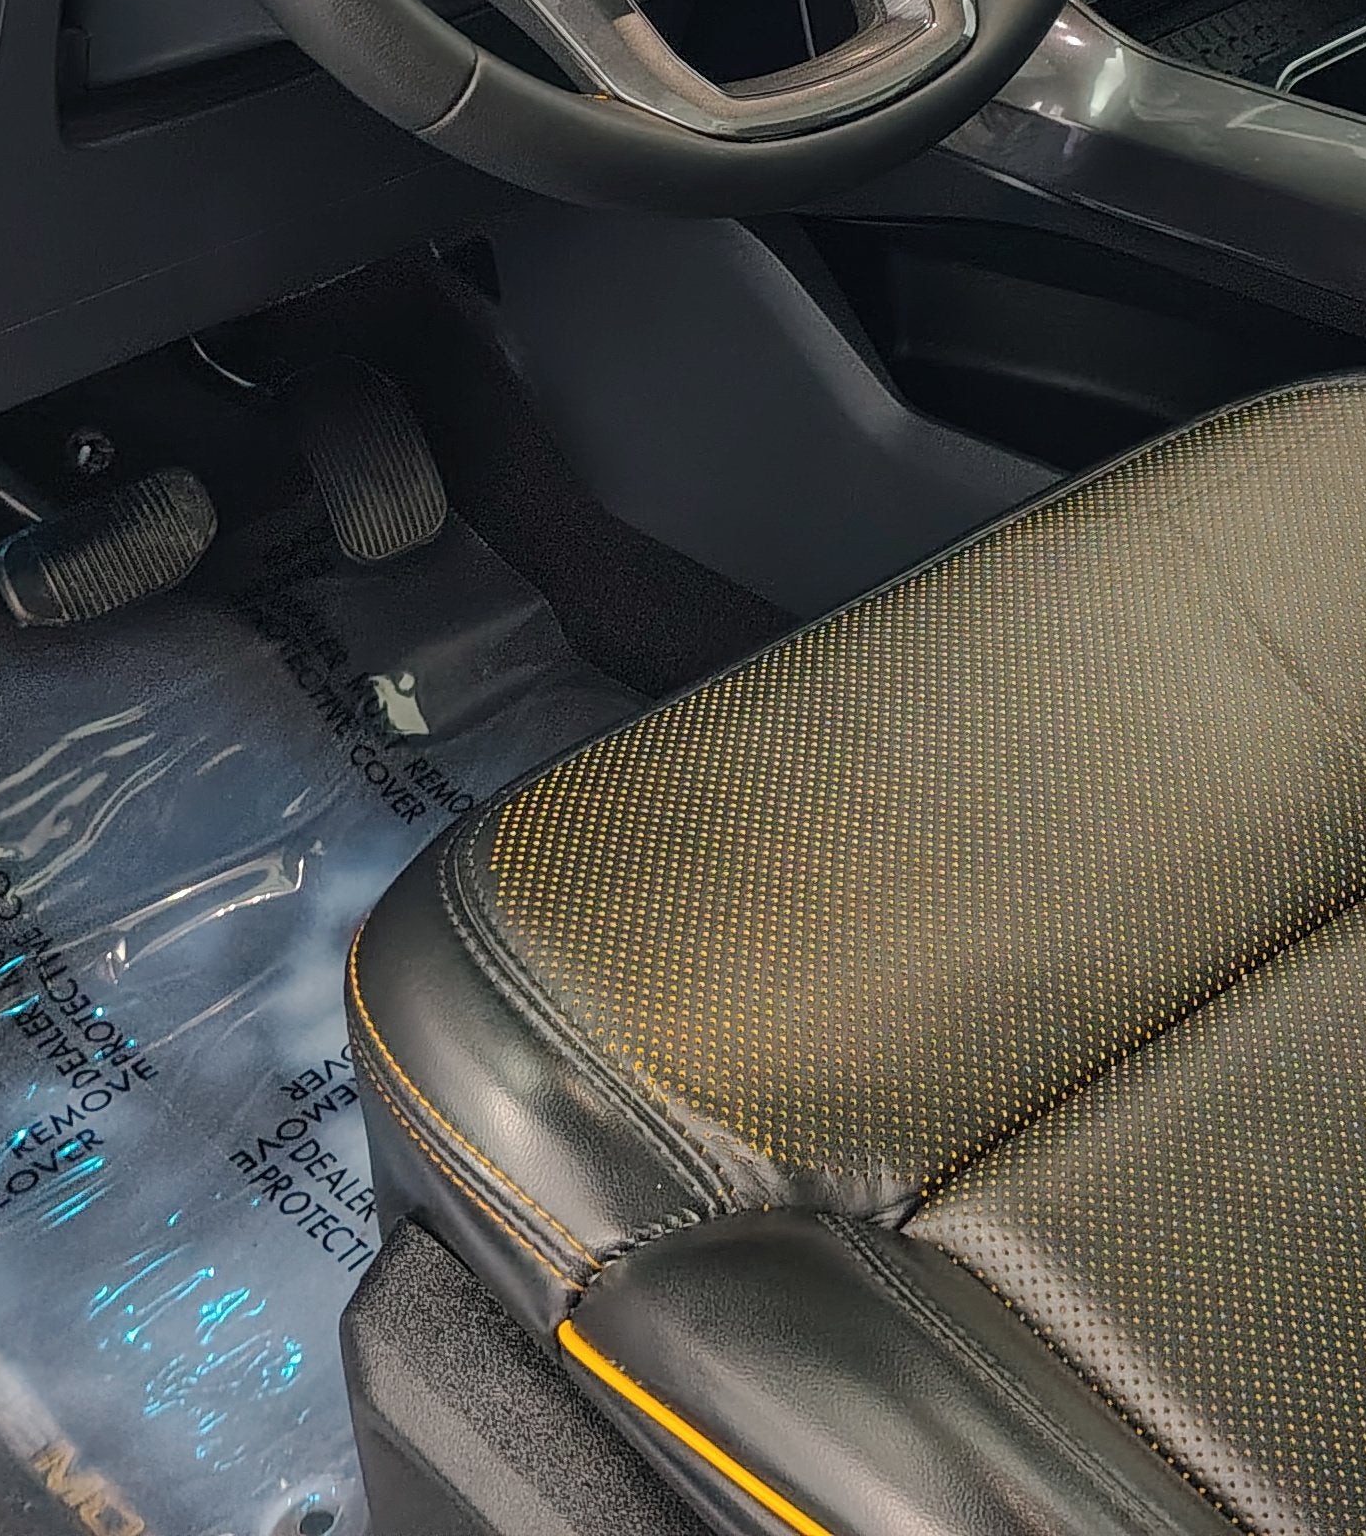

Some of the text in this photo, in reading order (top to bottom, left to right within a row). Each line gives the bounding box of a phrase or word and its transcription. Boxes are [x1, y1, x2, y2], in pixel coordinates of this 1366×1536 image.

[349, 744, 427, 826] COVER
[12, 1009, 100, 1092] DEALER
[10, 1055, 160, 1162] REMOVE
[289, 1139, 378, 1224] DEALER
